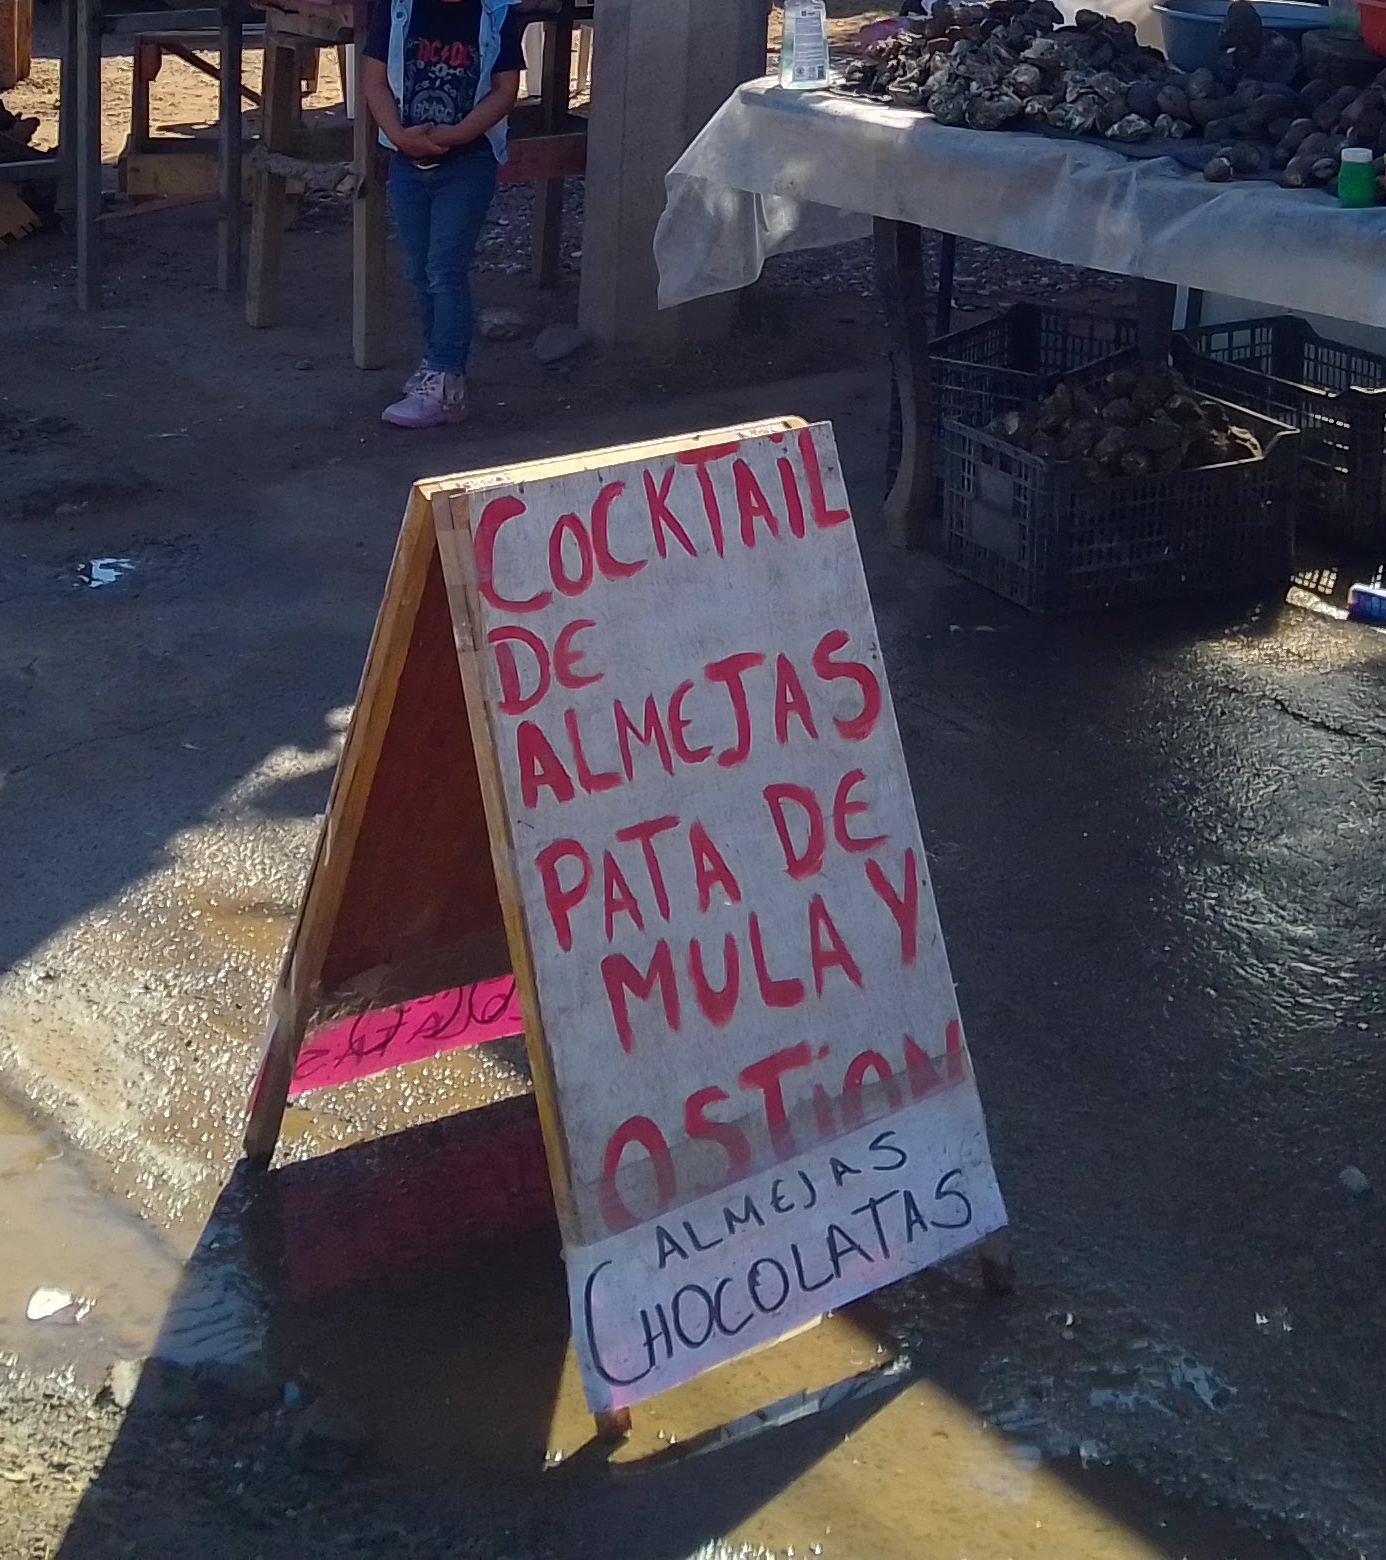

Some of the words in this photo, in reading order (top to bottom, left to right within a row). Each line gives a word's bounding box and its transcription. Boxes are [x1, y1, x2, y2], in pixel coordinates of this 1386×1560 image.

[474, 427, 851, 613] COCKTAIL
[488, 620, 605, 715] DE
[516, 629, 882, 808] ALMEJAS
[535, 815, 742, 952] PATA
[762, 768, 892, 881] DE
[599, 893, 865, 1054] MULA
[865, 848, 918, 966] Y
[584, 1169, 973, 1386] CHOCOLATAS
[655, 1130, 907, 1269] ALMEJAS
